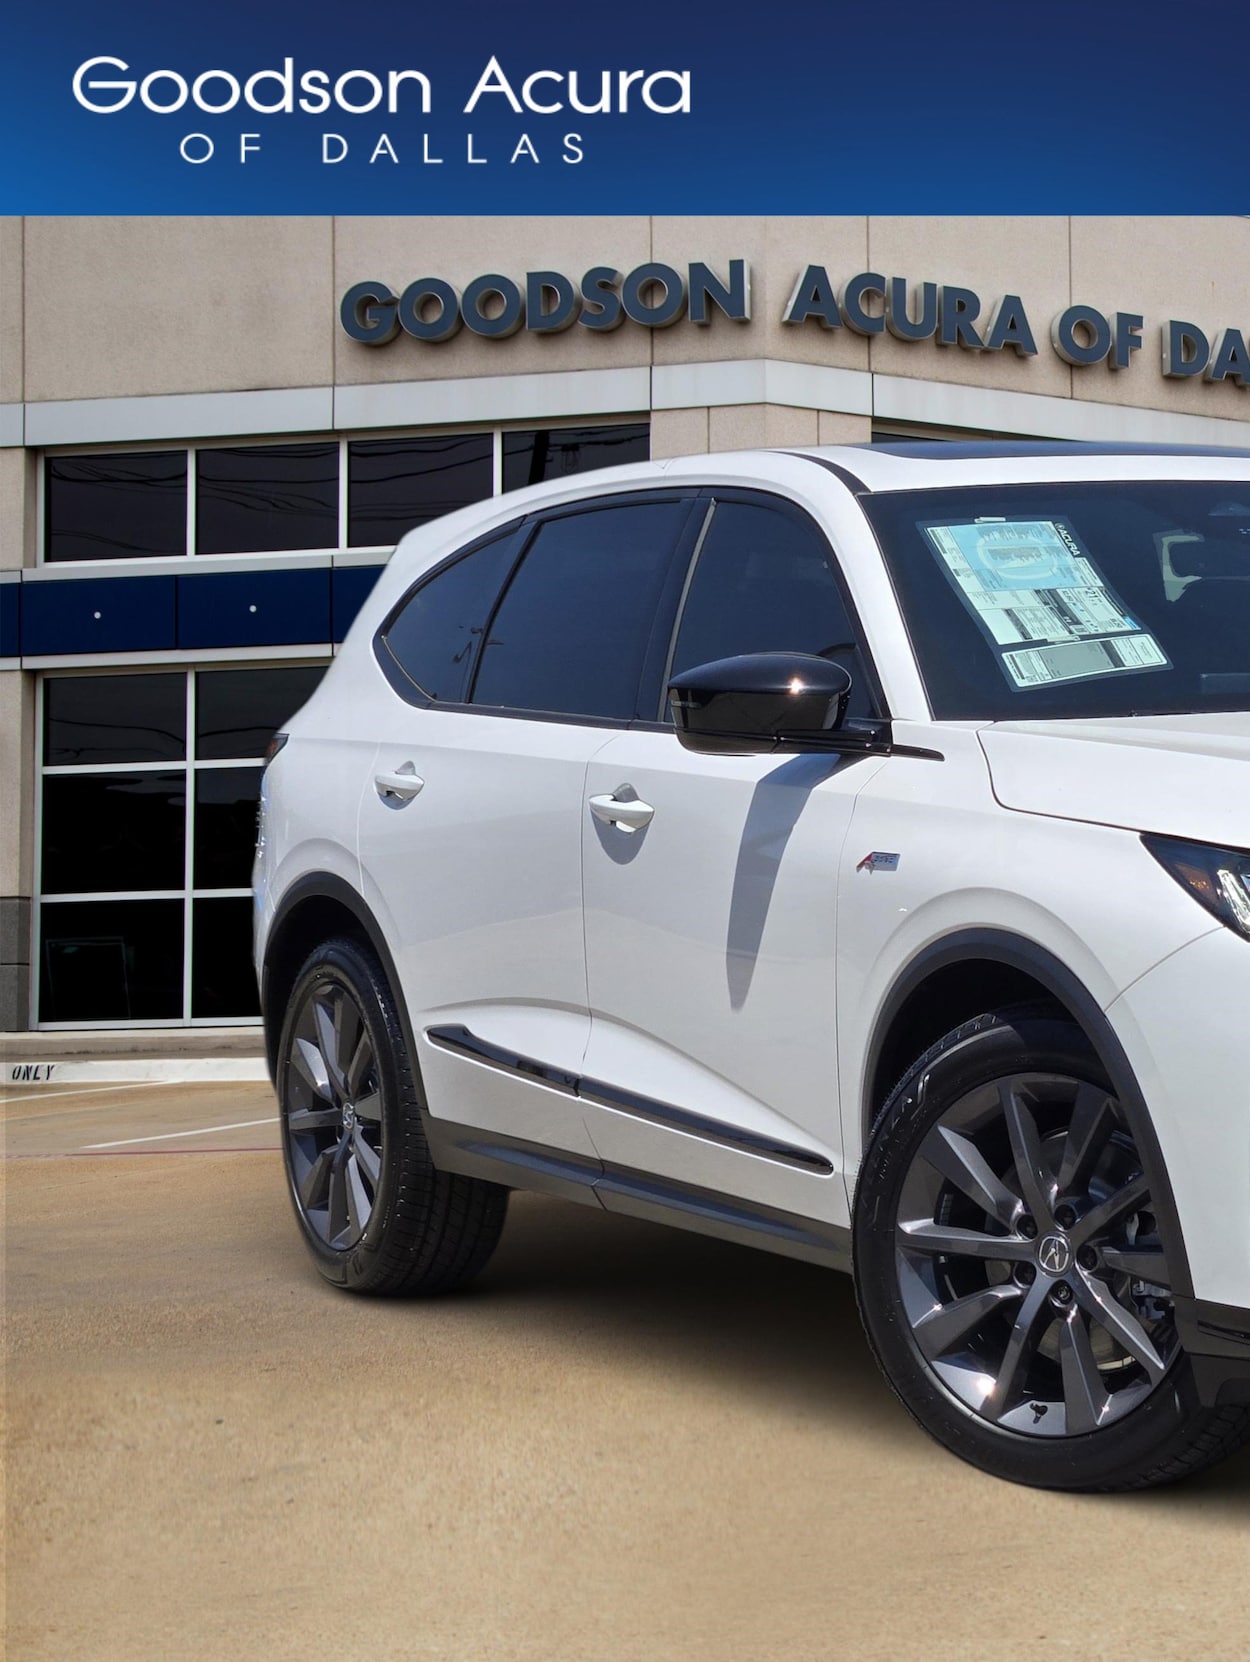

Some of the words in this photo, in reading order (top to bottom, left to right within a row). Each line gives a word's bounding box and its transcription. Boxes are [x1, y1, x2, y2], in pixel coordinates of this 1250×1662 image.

[341, 259, 752, 345] GOODSON
[782, 265, 1038, 356] ACURA
[1051, 305, 1143, 370] OF
[1060, 528, 1080, 556] ACURA
[12, 1065, 55, 1081] ONLY
